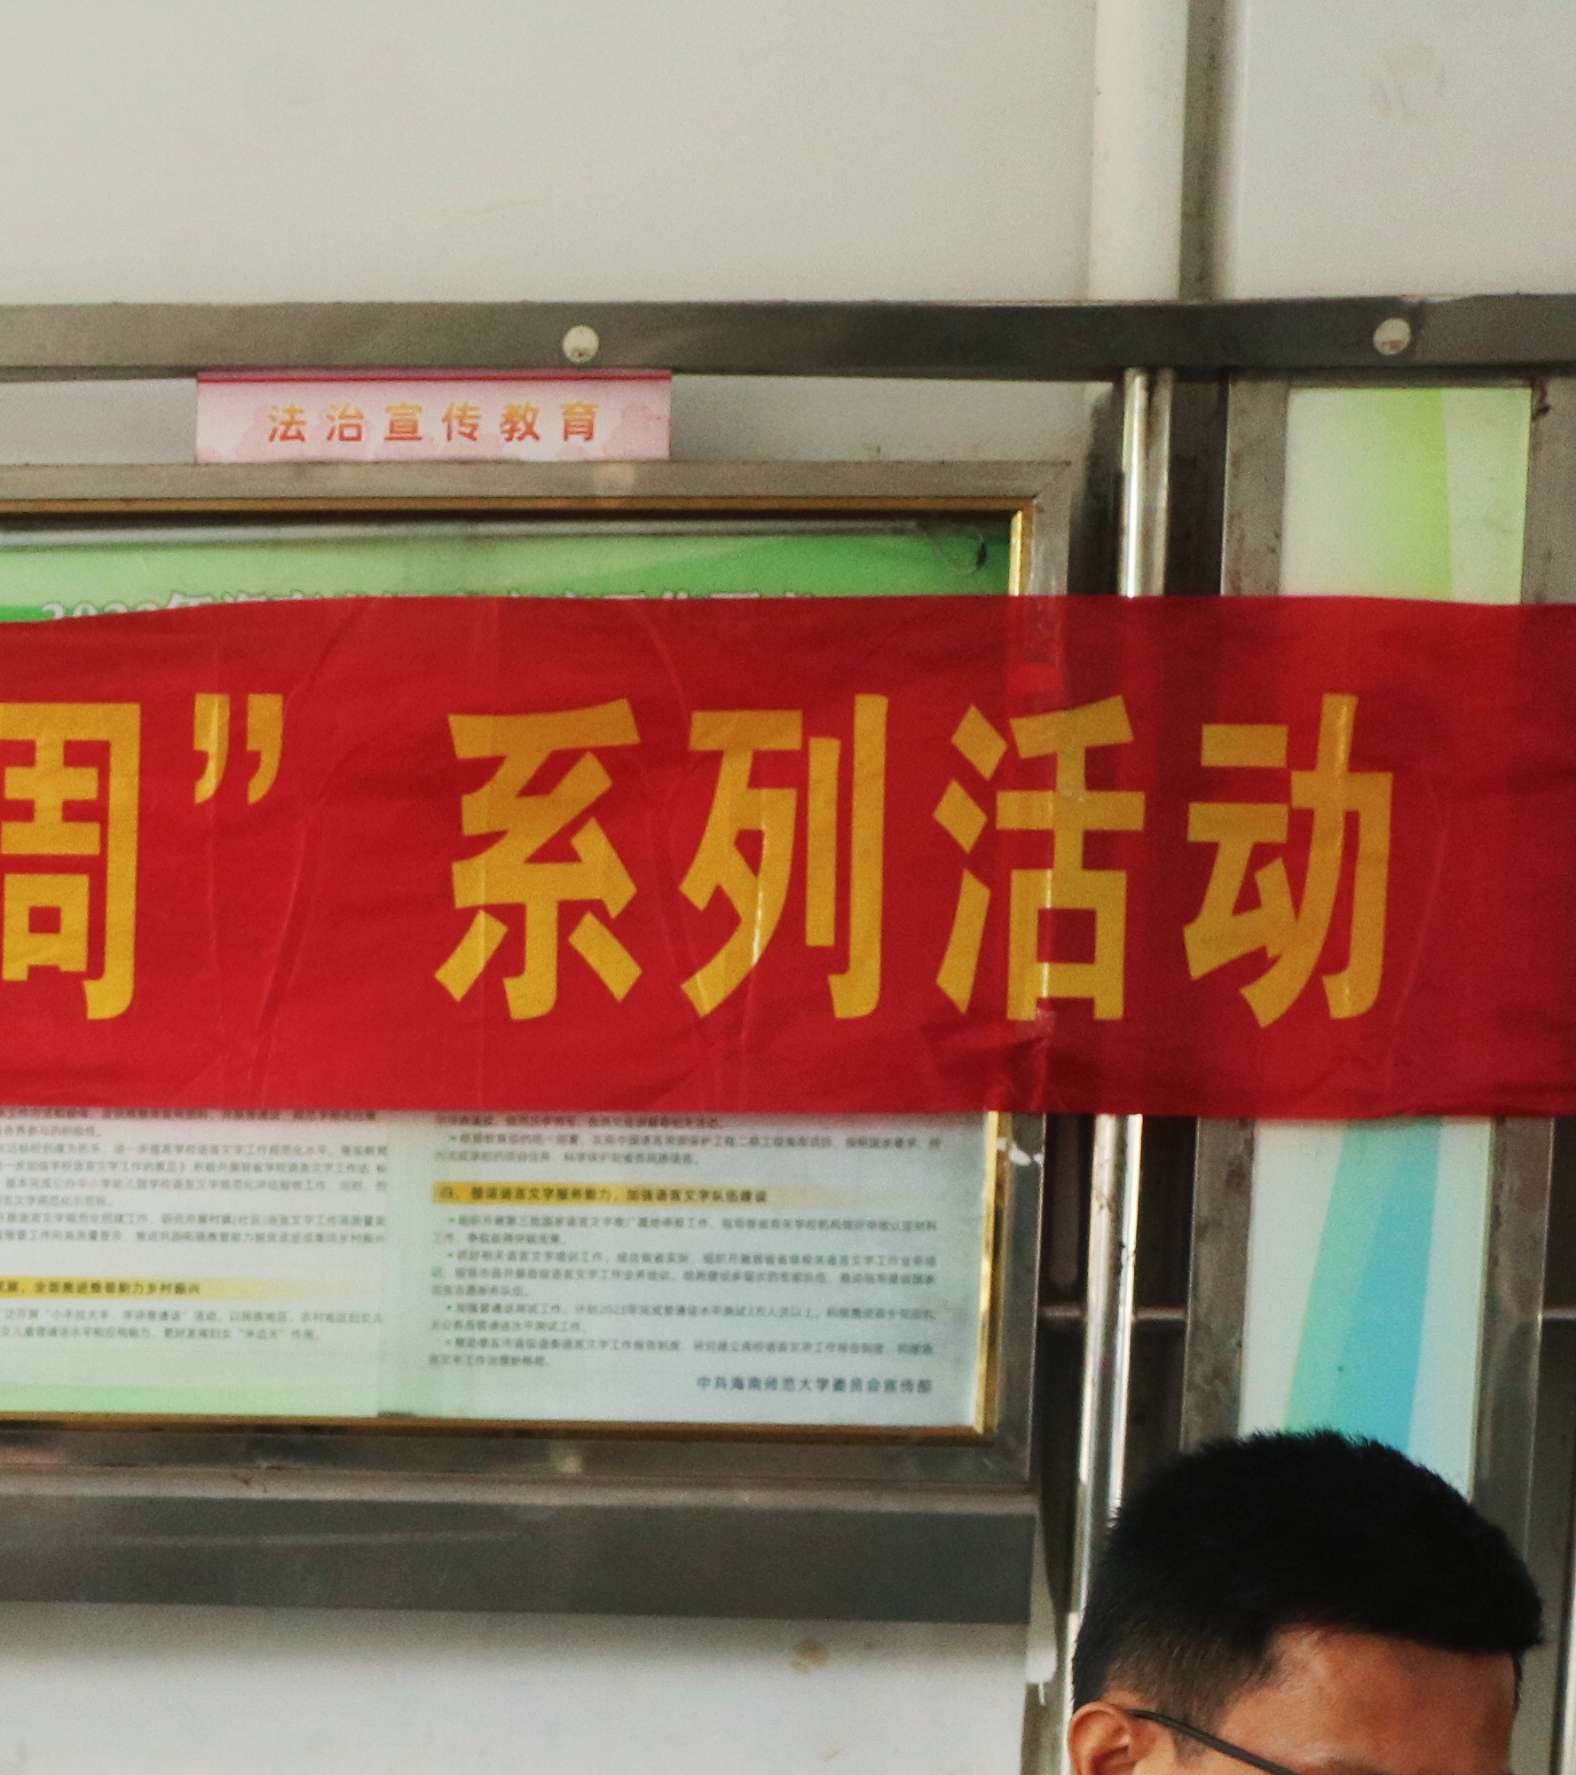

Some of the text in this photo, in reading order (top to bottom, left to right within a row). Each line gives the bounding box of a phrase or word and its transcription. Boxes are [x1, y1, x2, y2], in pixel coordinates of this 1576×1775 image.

[265, 400, 602, 446] 法治宣传教育
[435, 693, 1395, 1027] 系列活动
